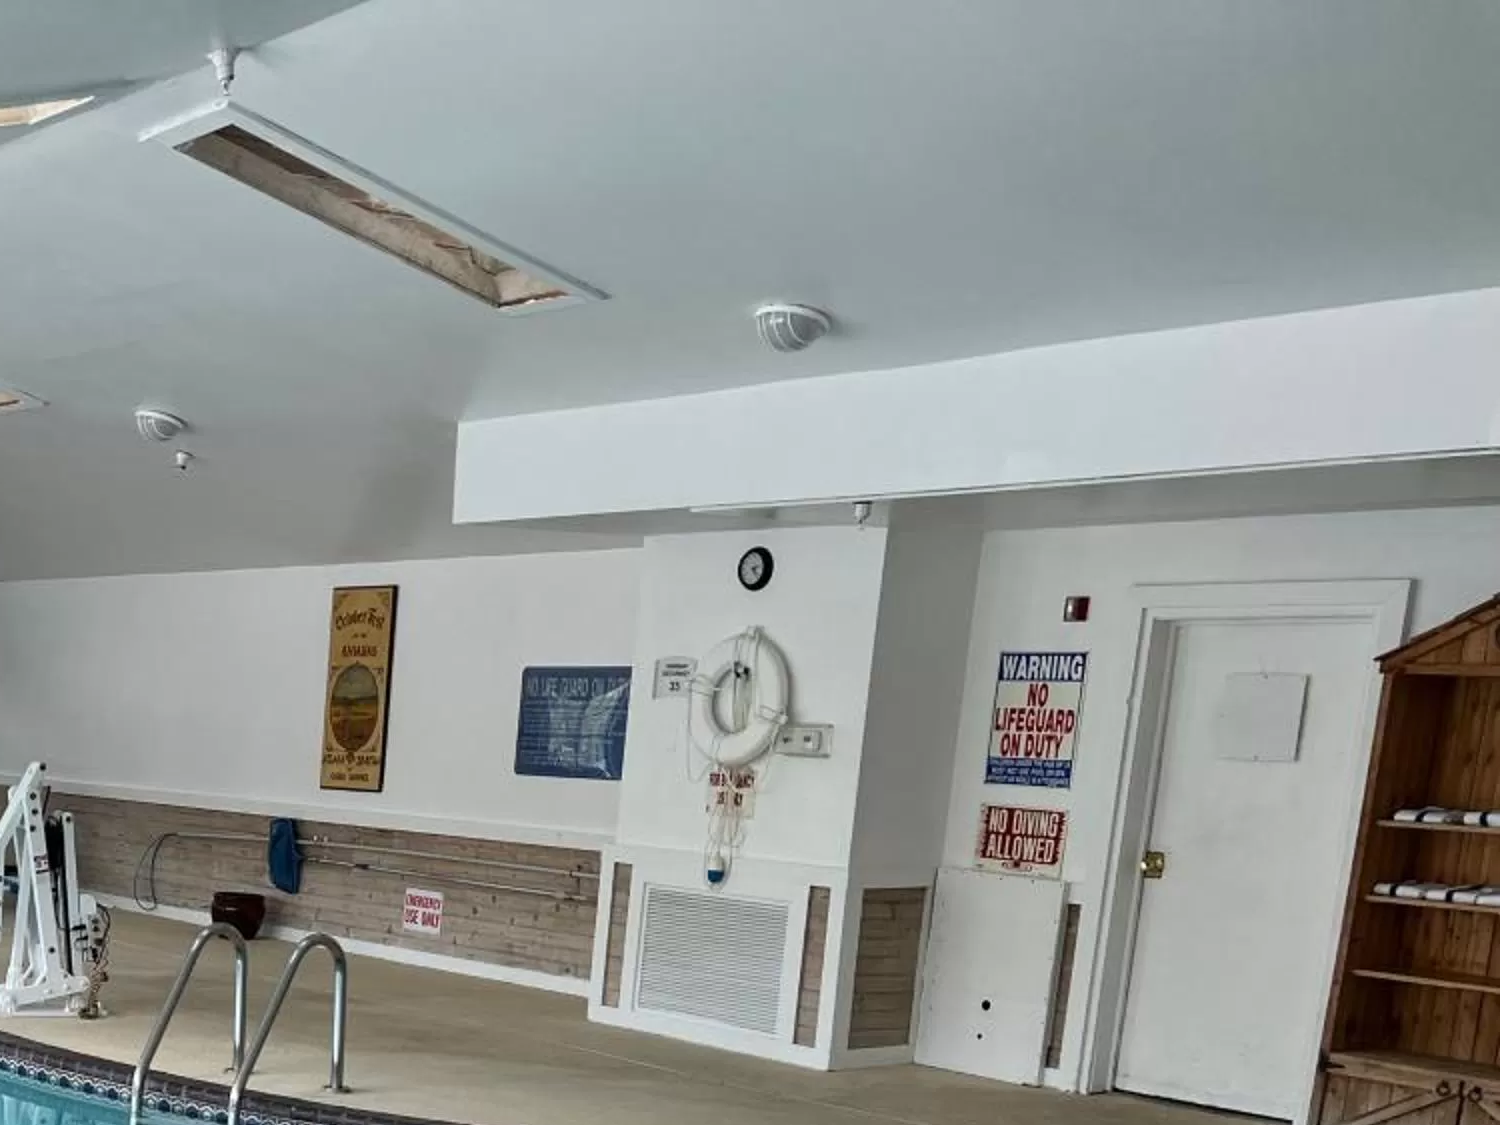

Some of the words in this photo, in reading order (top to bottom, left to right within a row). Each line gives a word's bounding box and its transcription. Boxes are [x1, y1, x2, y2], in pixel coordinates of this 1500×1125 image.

[1002, 654, 1083, 680] WARNING
[1027, 683, 1049, 707] NO
[995, 707, 1075, 734] LIFEGUARD
[1000, 733, 1021, 757] ON
[1024, 734, 1063, 758] DUTY
[988, 807, 1009, 833] NO
[1011, 809, 1060, 837] DIVING
[986, 833, 1055, 863] ALLOWED
